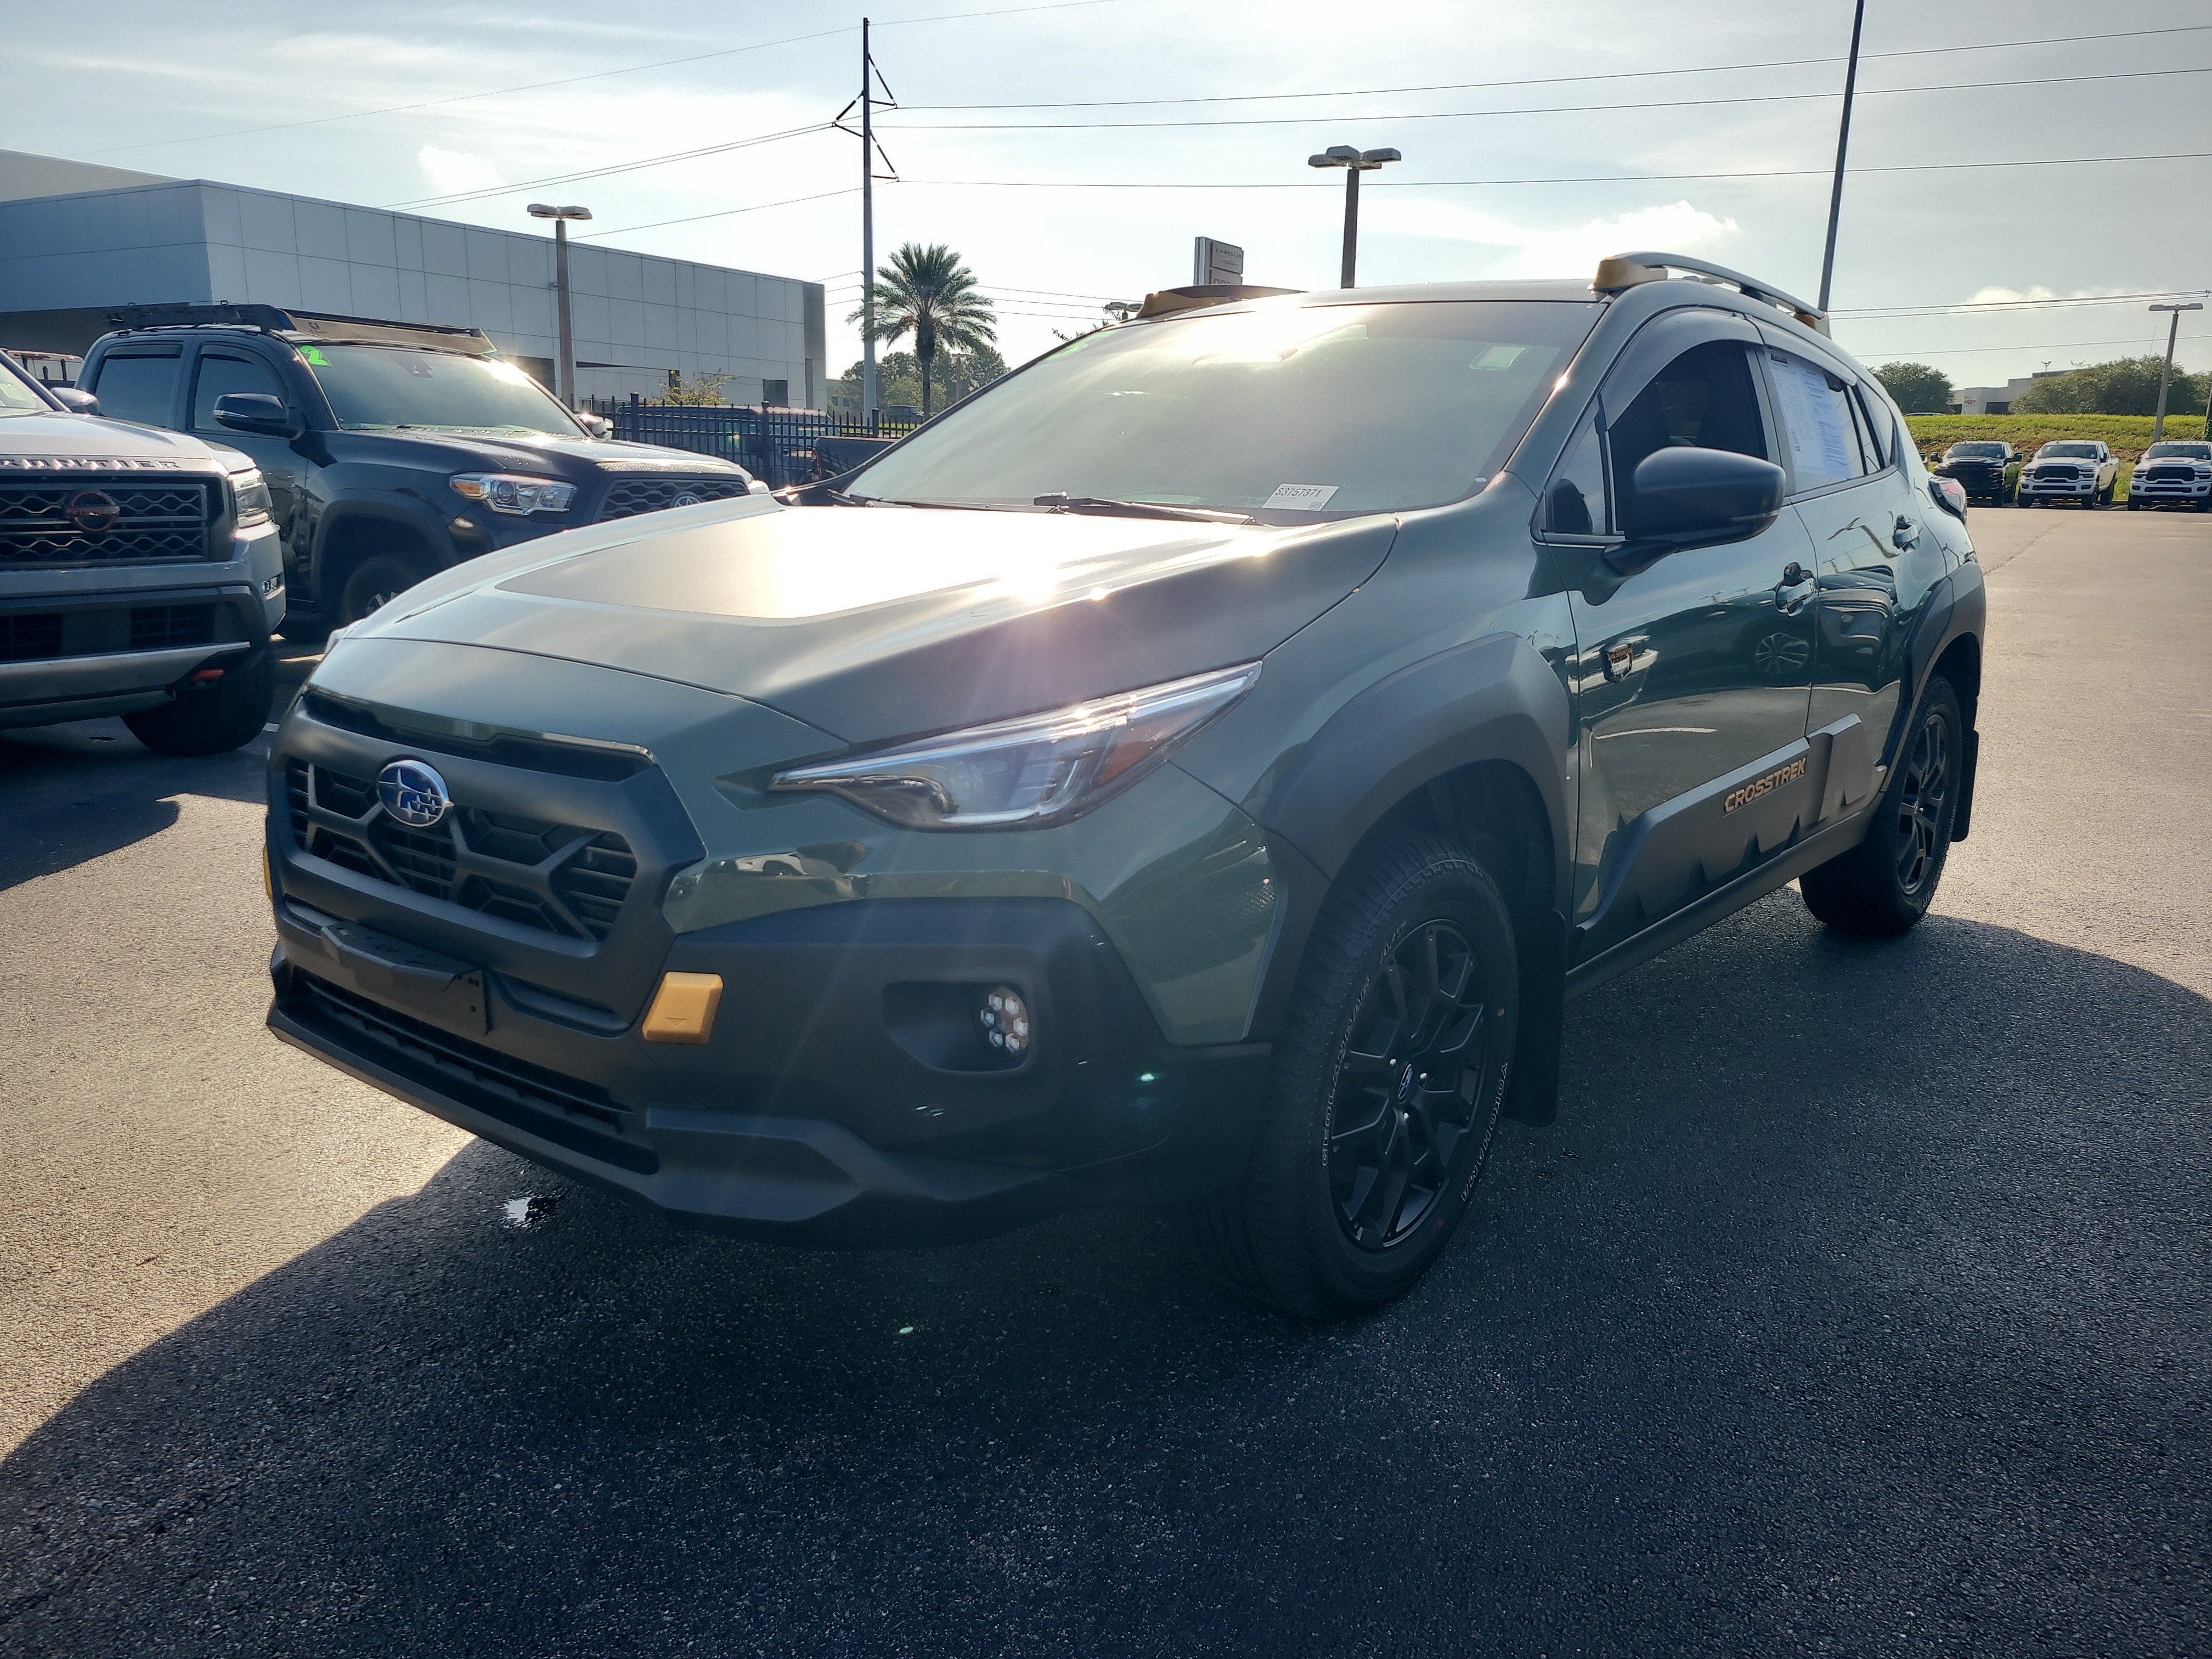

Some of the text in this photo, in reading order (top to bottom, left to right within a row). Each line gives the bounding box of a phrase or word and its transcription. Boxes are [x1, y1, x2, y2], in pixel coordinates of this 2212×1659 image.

[1216, 248, 1242, 258] CHRYSLER
[1274, 487, 1323, 498] S3757371
[1724, 757, 1807, 812] CROSSTREK
[1460, 1062, 1508, 1202] YOKOHAMA
